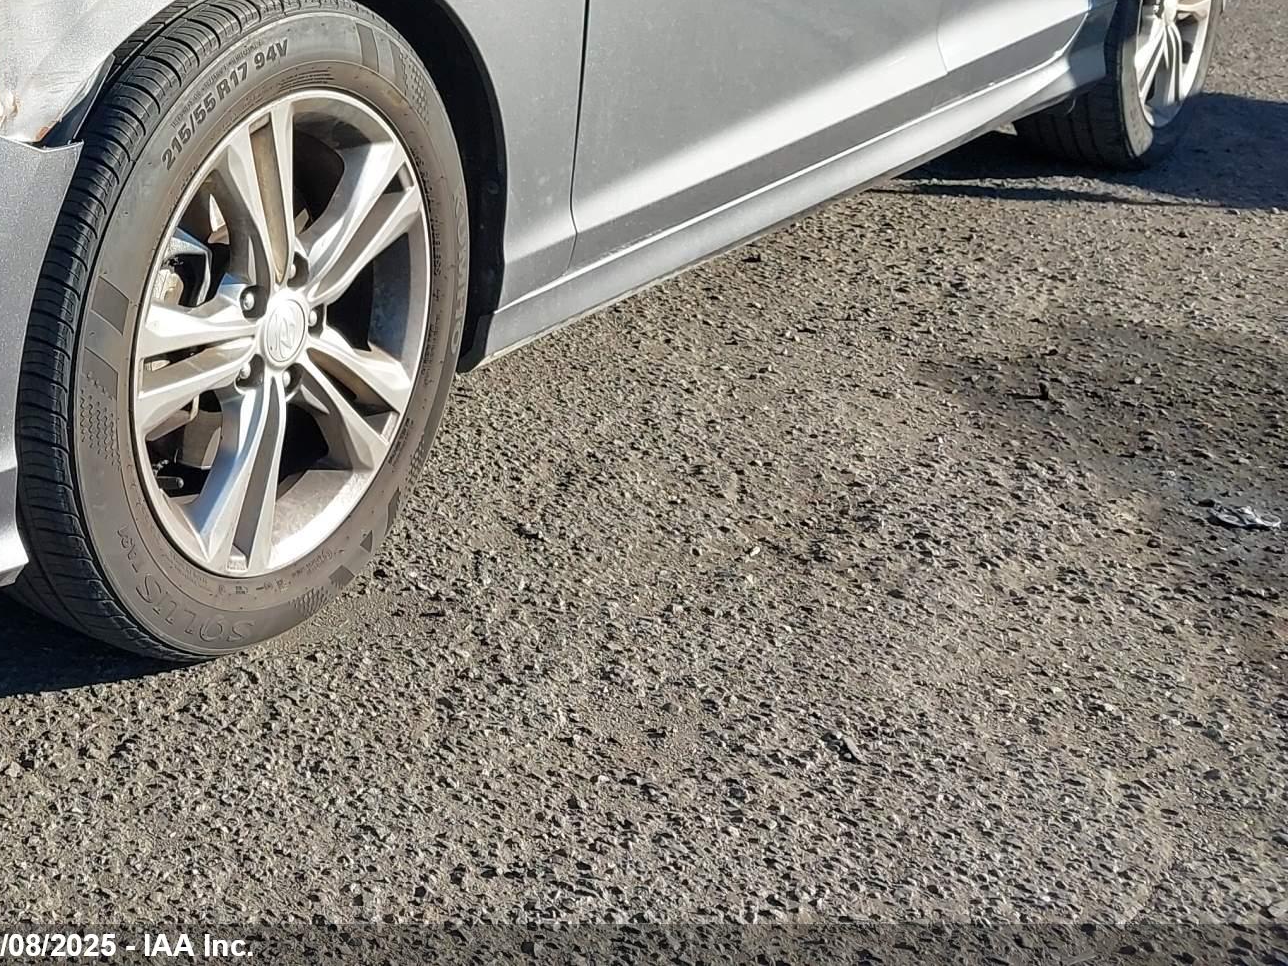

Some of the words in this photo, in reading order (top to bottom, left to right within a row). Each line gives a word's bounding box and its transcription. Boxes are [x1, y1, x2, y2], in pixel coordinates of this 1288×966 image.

[162, 92, 216, 170] 215/55
[216, 61, 248, 101] R17
[253, 38, 288, 71] 94V
